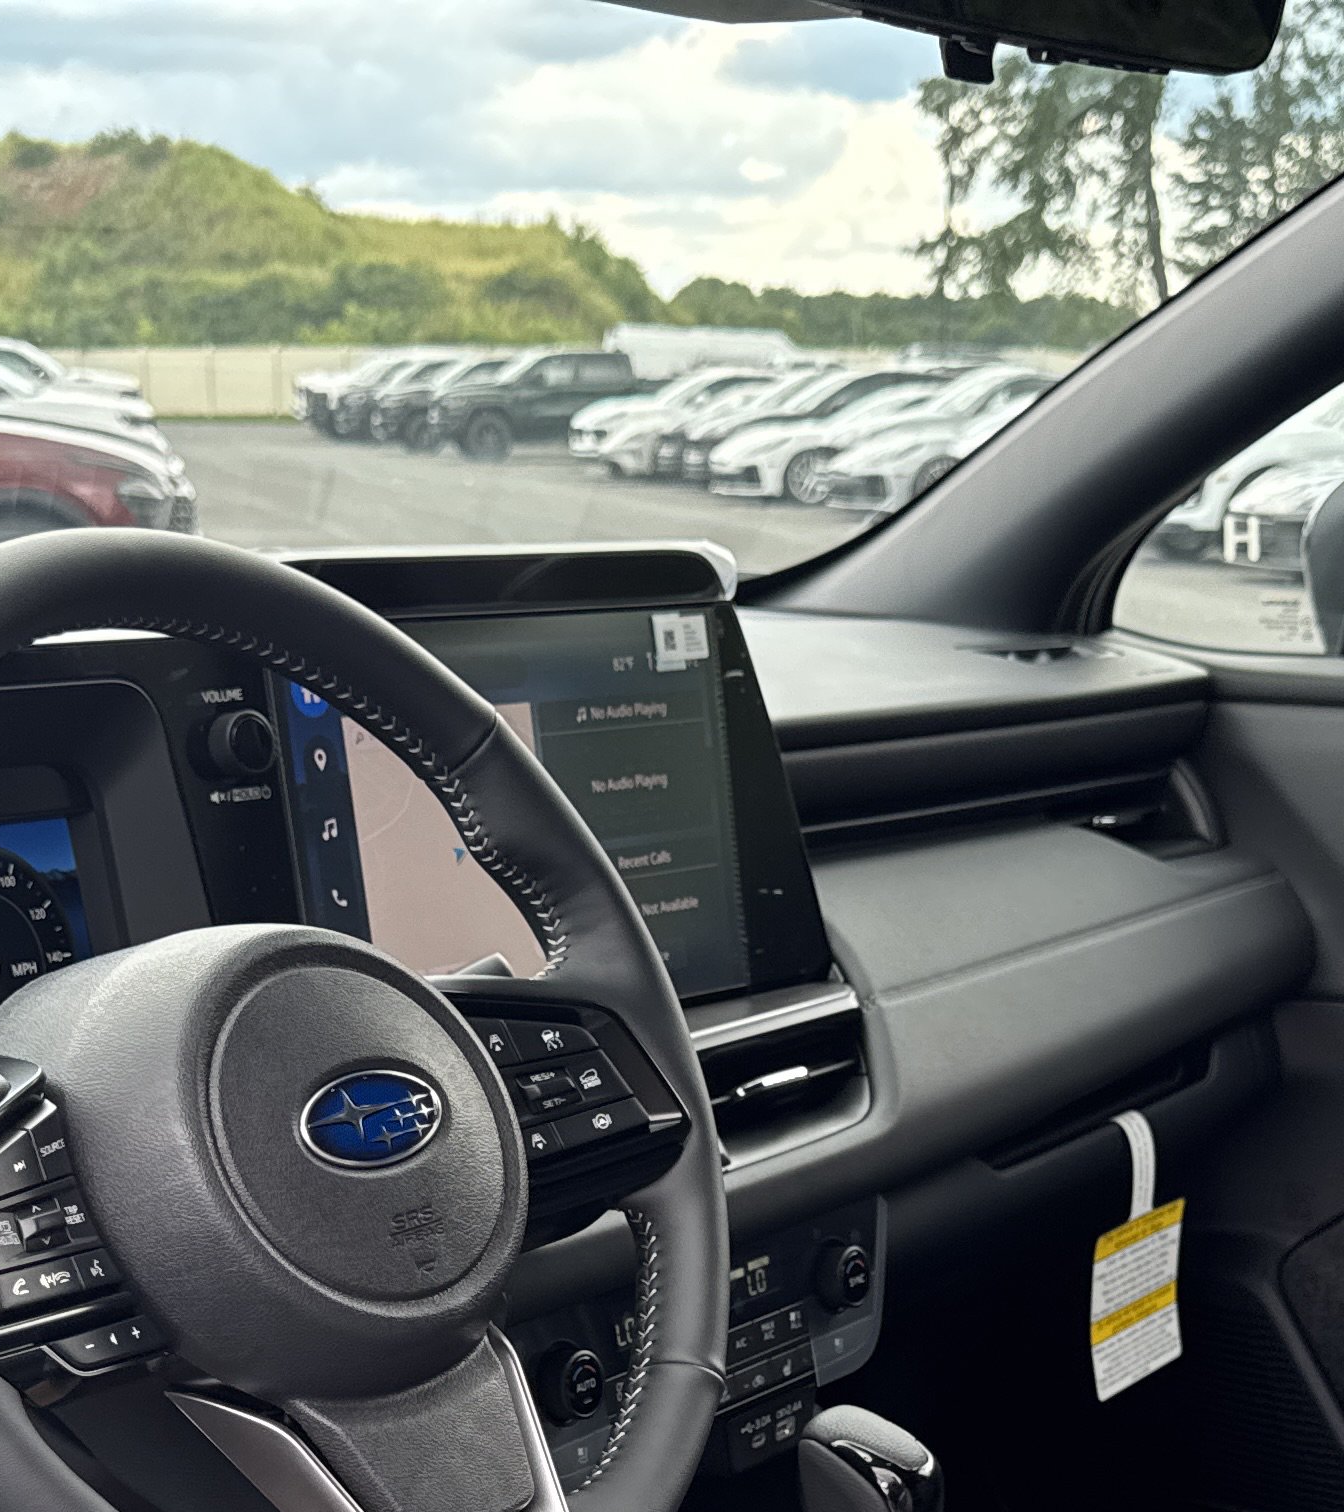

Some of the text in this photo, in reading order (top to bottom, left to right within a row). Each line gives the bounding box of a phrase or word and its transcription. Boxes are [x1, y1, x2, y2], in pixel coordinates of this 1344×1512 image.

[201, 688, 243, 704] VOLUME
[590, 702, 668, 720] No Audio Playing
[592, 773, 668, 794] No Audio Playing
[618, 850, 672, 870] Recent Calls
[660, 896, 699, 914] Available
[29, 908, 47, 921] 120
[45, 951, 63, 963] 140
[11, 961, 38, 978] MPH
[39, 1138, 66, 1158] SOURCE
[63, 1204, 79, 1214] TRIP
[392, 1204, 433, 1230] SRS
[65, 1213, 86, 1225] RESET
[746, 1268, 767, 1296] LO
[576, 1377, 596, 1393] AUTO
